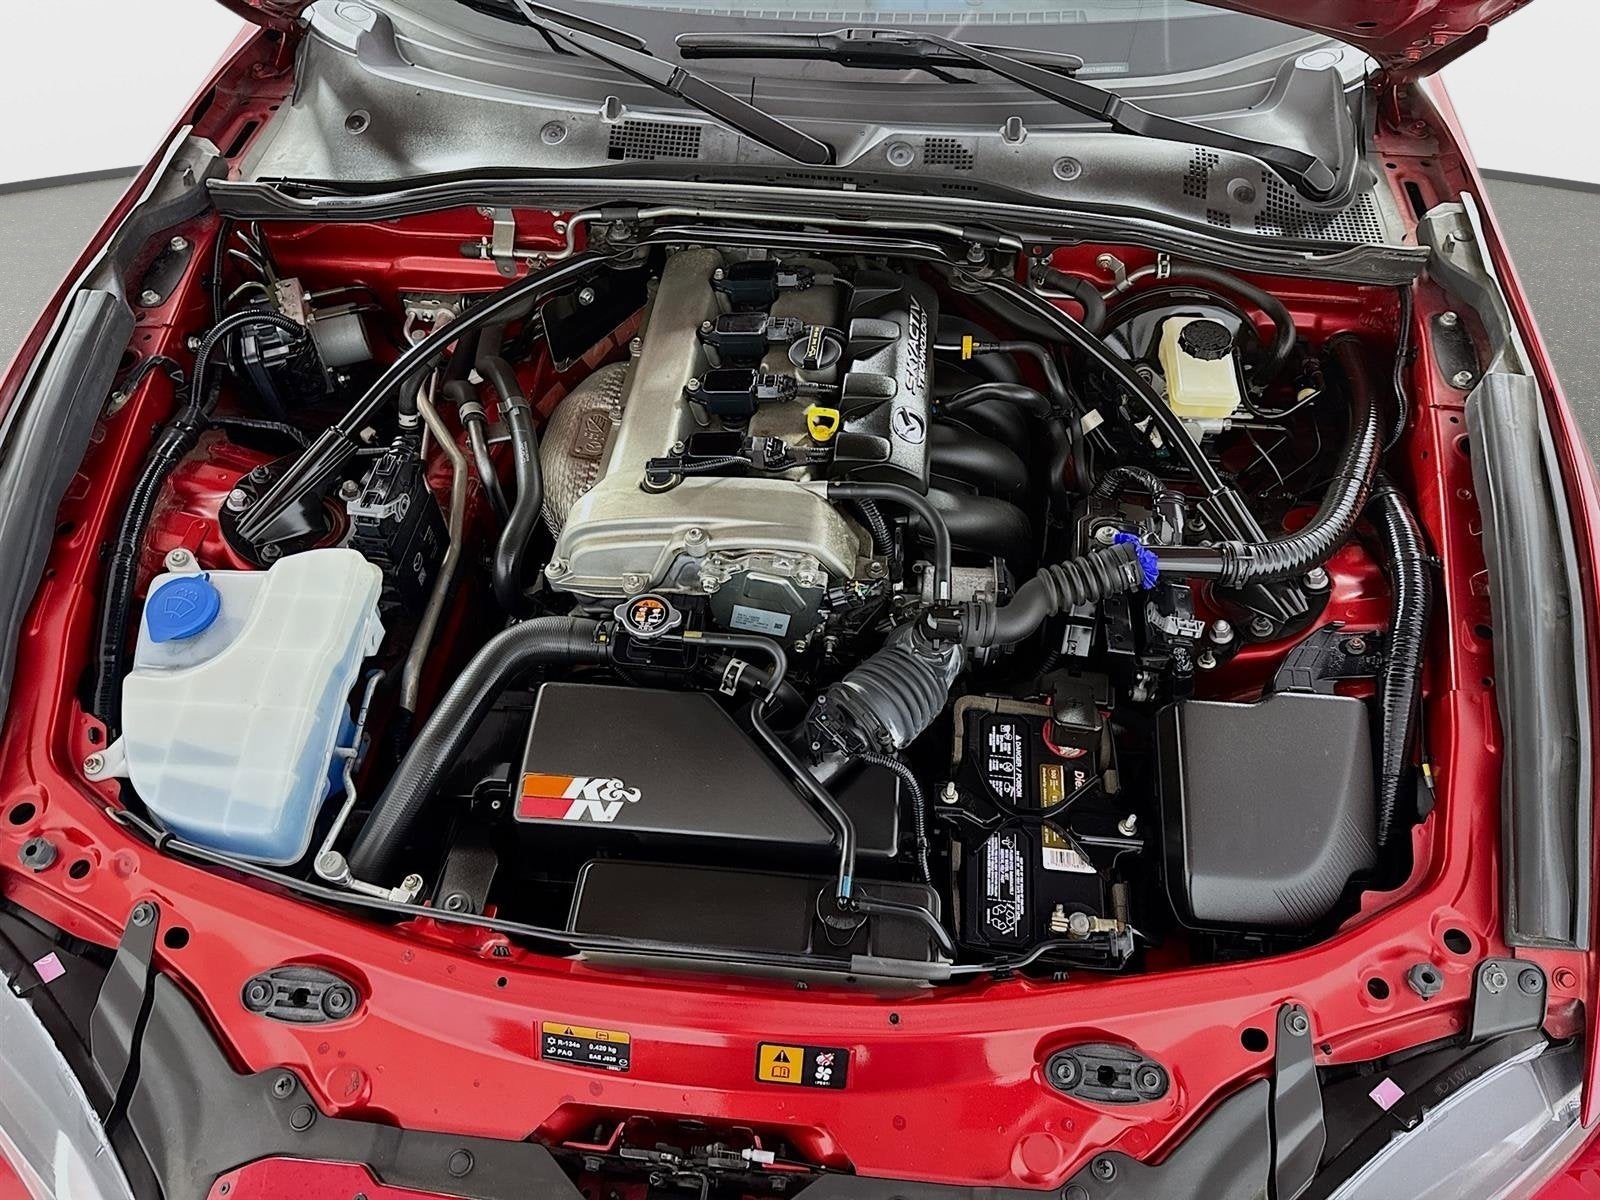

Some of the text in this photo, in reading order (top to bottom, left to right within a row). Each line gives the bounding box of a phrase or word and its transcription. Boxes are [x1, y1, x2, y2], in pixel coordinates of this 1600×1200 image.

[905, 294, 921, 396] SKYACTIV
[917, 306, 929, 390] TECHNOLOGY
[561, 776, 642, 822] K&N
[608, 1046, 617, 1054] kg
